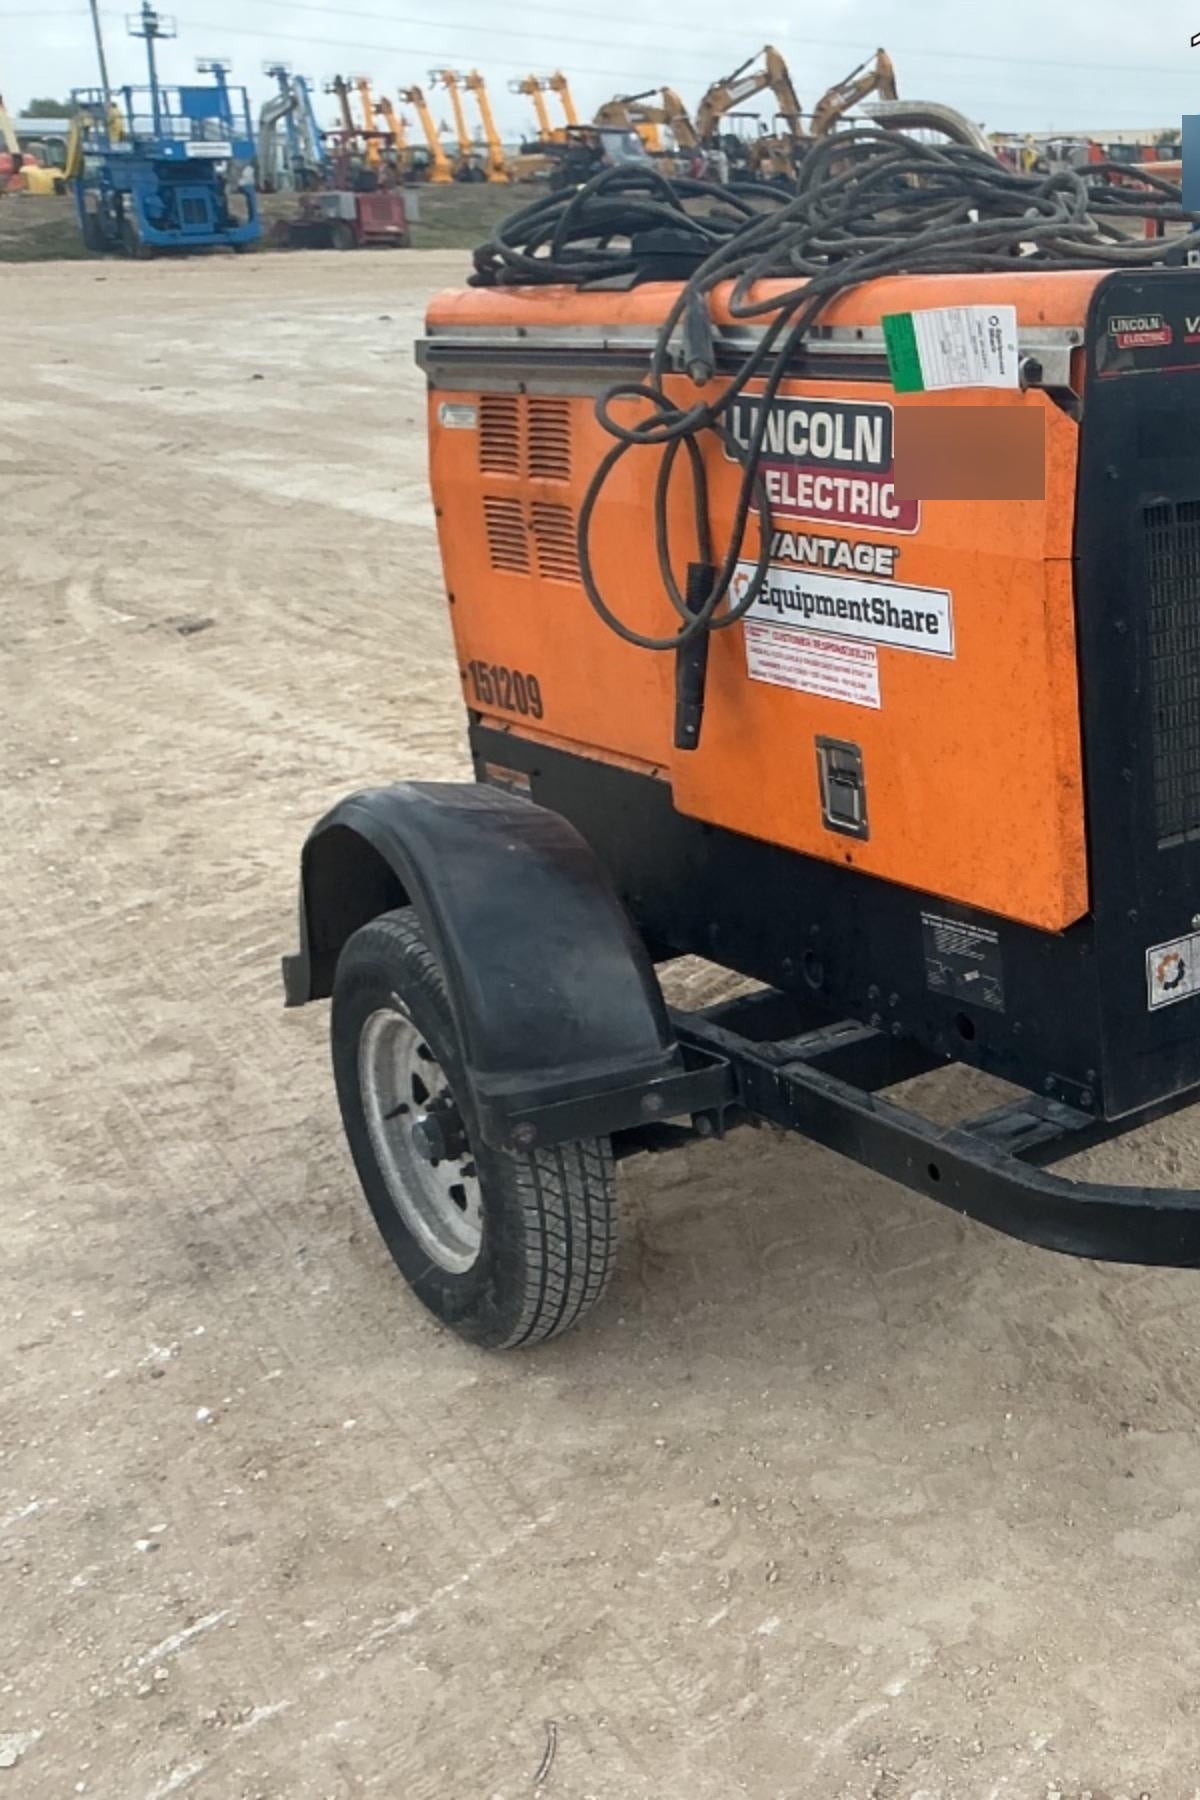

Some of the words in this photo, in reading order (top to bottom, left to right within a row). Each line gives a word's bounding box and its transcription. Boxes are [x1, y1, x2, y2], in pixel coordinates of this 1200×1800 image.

[1111, 318, 1160, 332] LINCOLN
[765, 470, 900, 519] ELECTRIC
[758, 579, 939, 635] EquipmentShare
[468, 660, 544, 719] 151209
